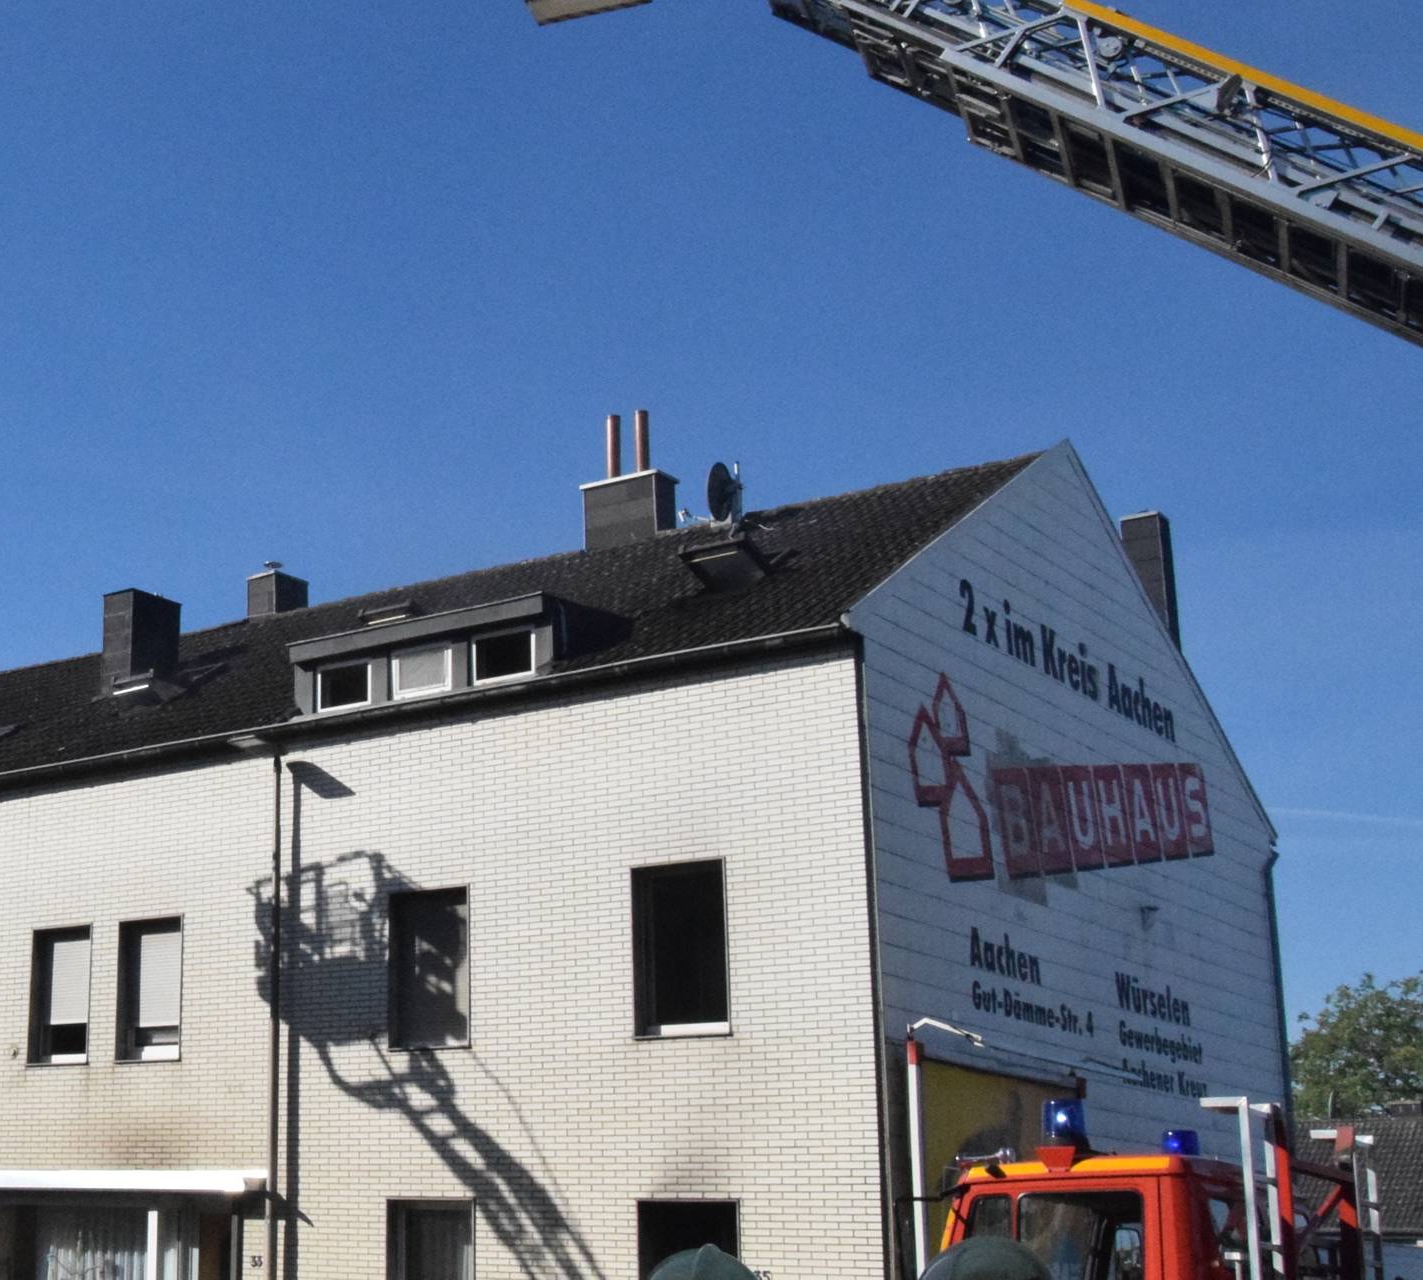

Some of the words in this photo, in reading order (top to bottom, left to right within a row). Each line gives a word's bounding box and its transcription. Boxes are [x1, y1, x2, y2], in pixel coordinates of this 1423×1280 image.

[960, 579, 977, 636] 2
[983, 606, 999, 648] x
[1004, 599, 1036, 667] im
[1040, 624, 1100, 701] Kreis
[1108, 663, 1176, 743] Aachen
[999, 776, 1207, 857] BAUHAUS
[970, 926, 1042, 986] Aachen
[972, 980, 1083, 1036] Gut-Dämme-Str.
[1086, 1011, 1094, 1038] 4
[1114, 971, 1191, 1026] Würselen
[1119, 1020, 1203, 1065] Gewerbegebiet
